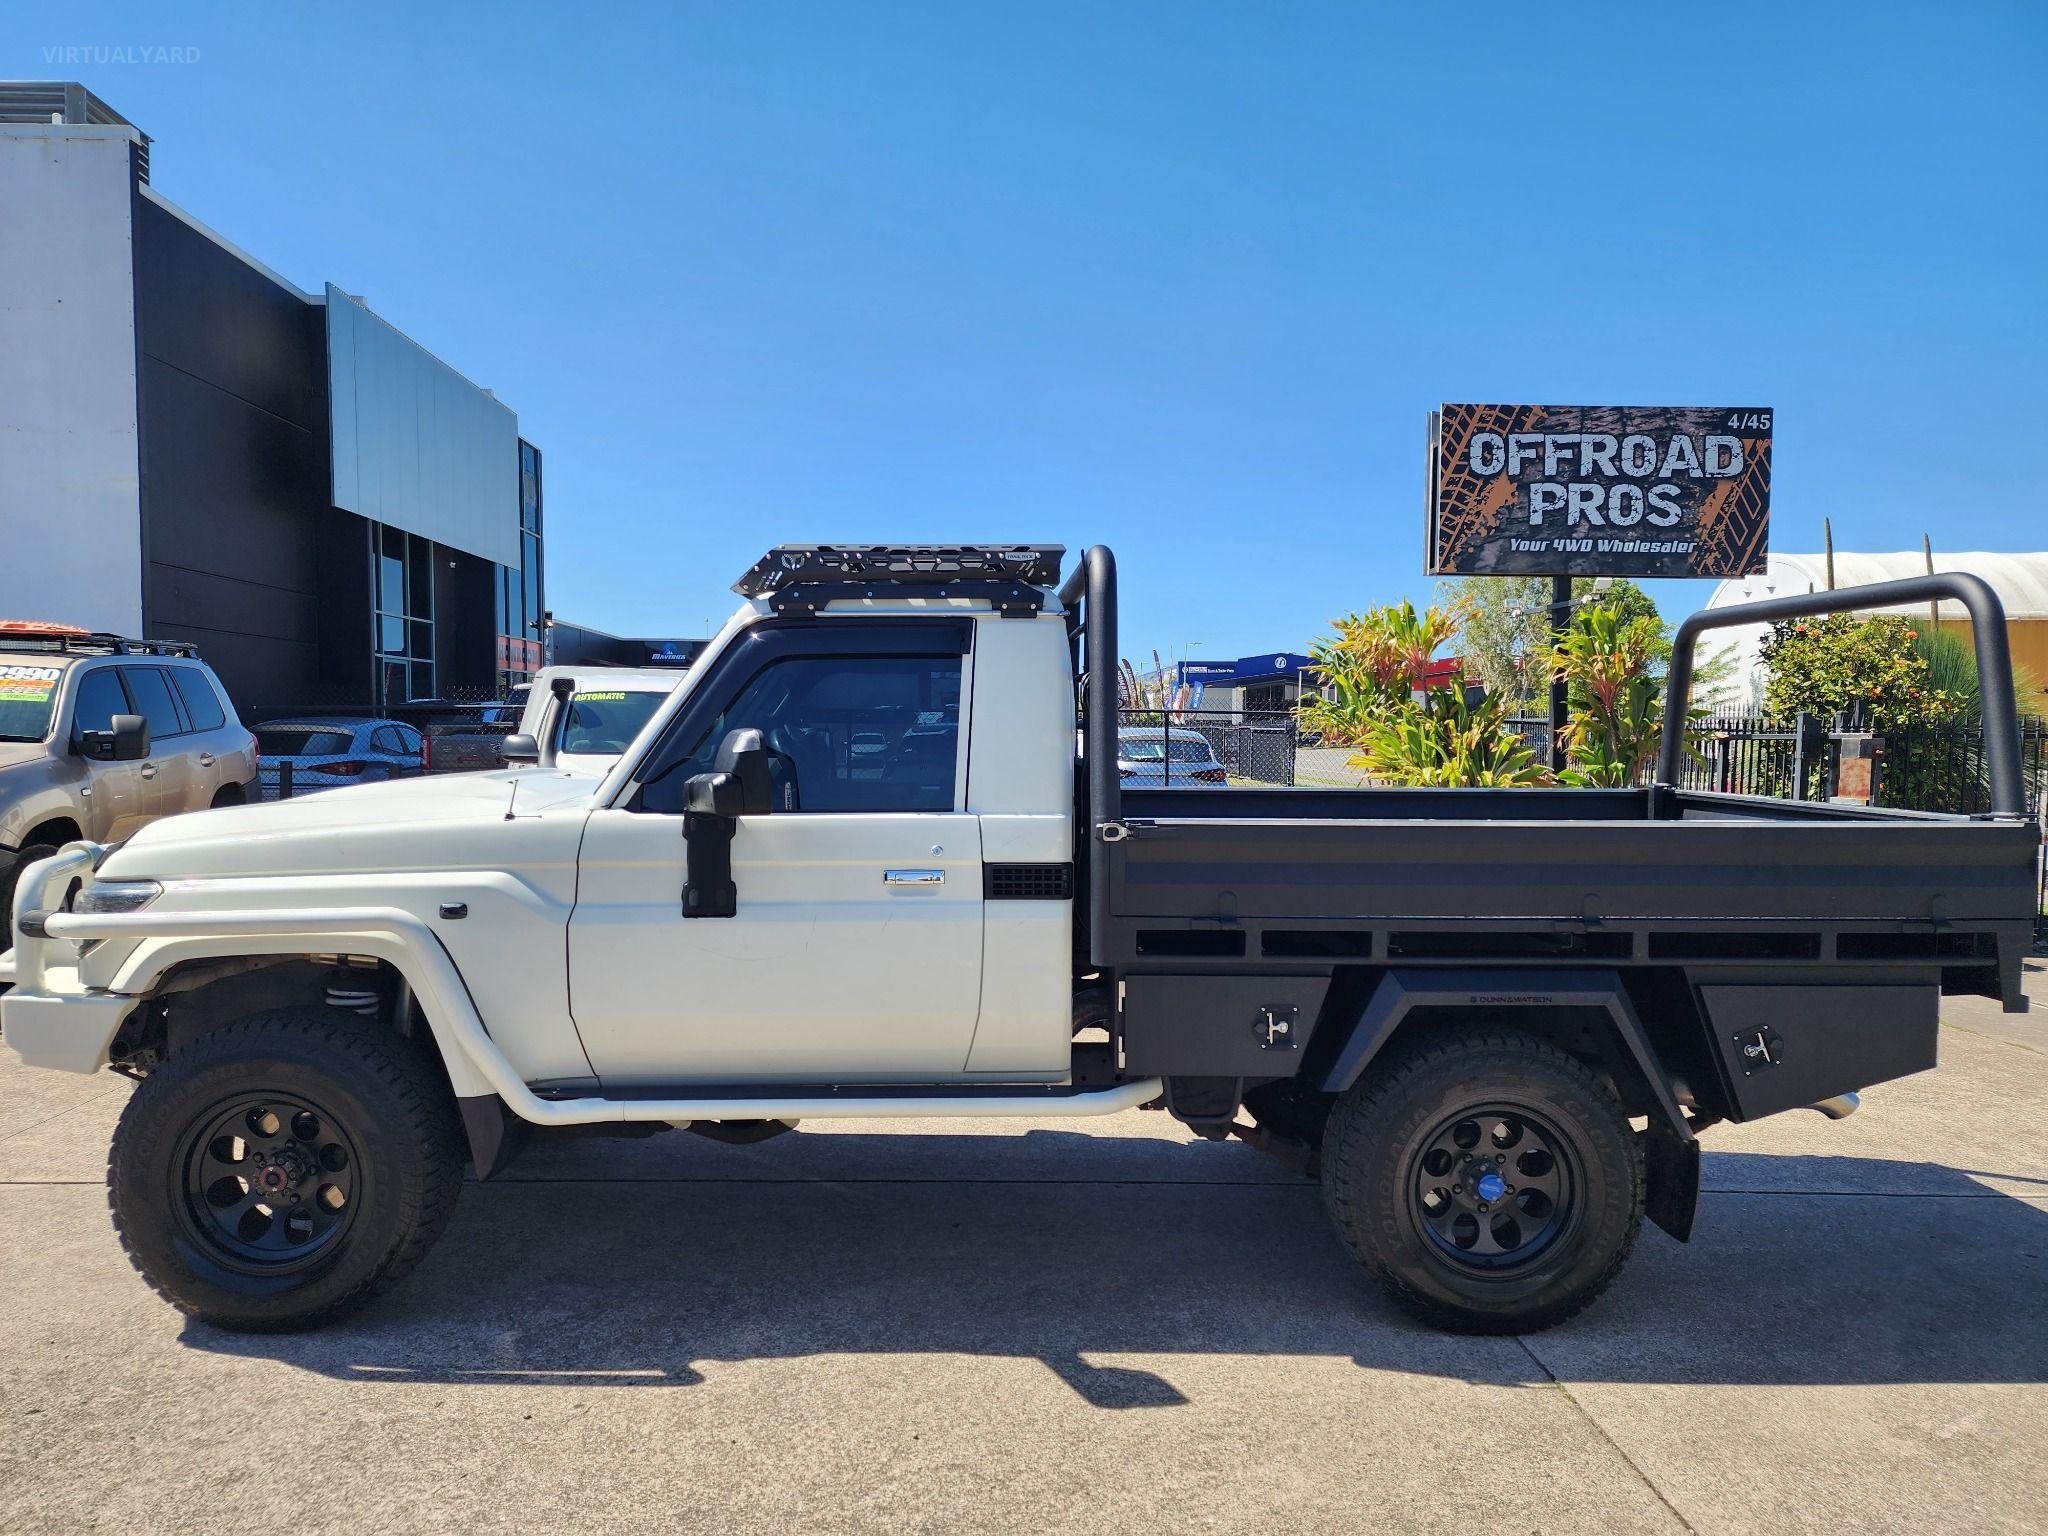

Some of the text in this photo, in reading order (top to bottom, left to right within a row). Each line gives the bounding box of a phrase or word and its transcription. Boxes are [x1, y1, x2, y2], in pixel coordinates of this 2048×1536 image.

[1727, 414, 1772, 430] 4/45
[1469, 432, 1745, 478] OFFROAD
[1529, 483, 1682, 527] PROS
[1510, 538, 1698, 554] Your 4WD Wholesaler
[575, 692, 626, 702] AUTOMATIC
